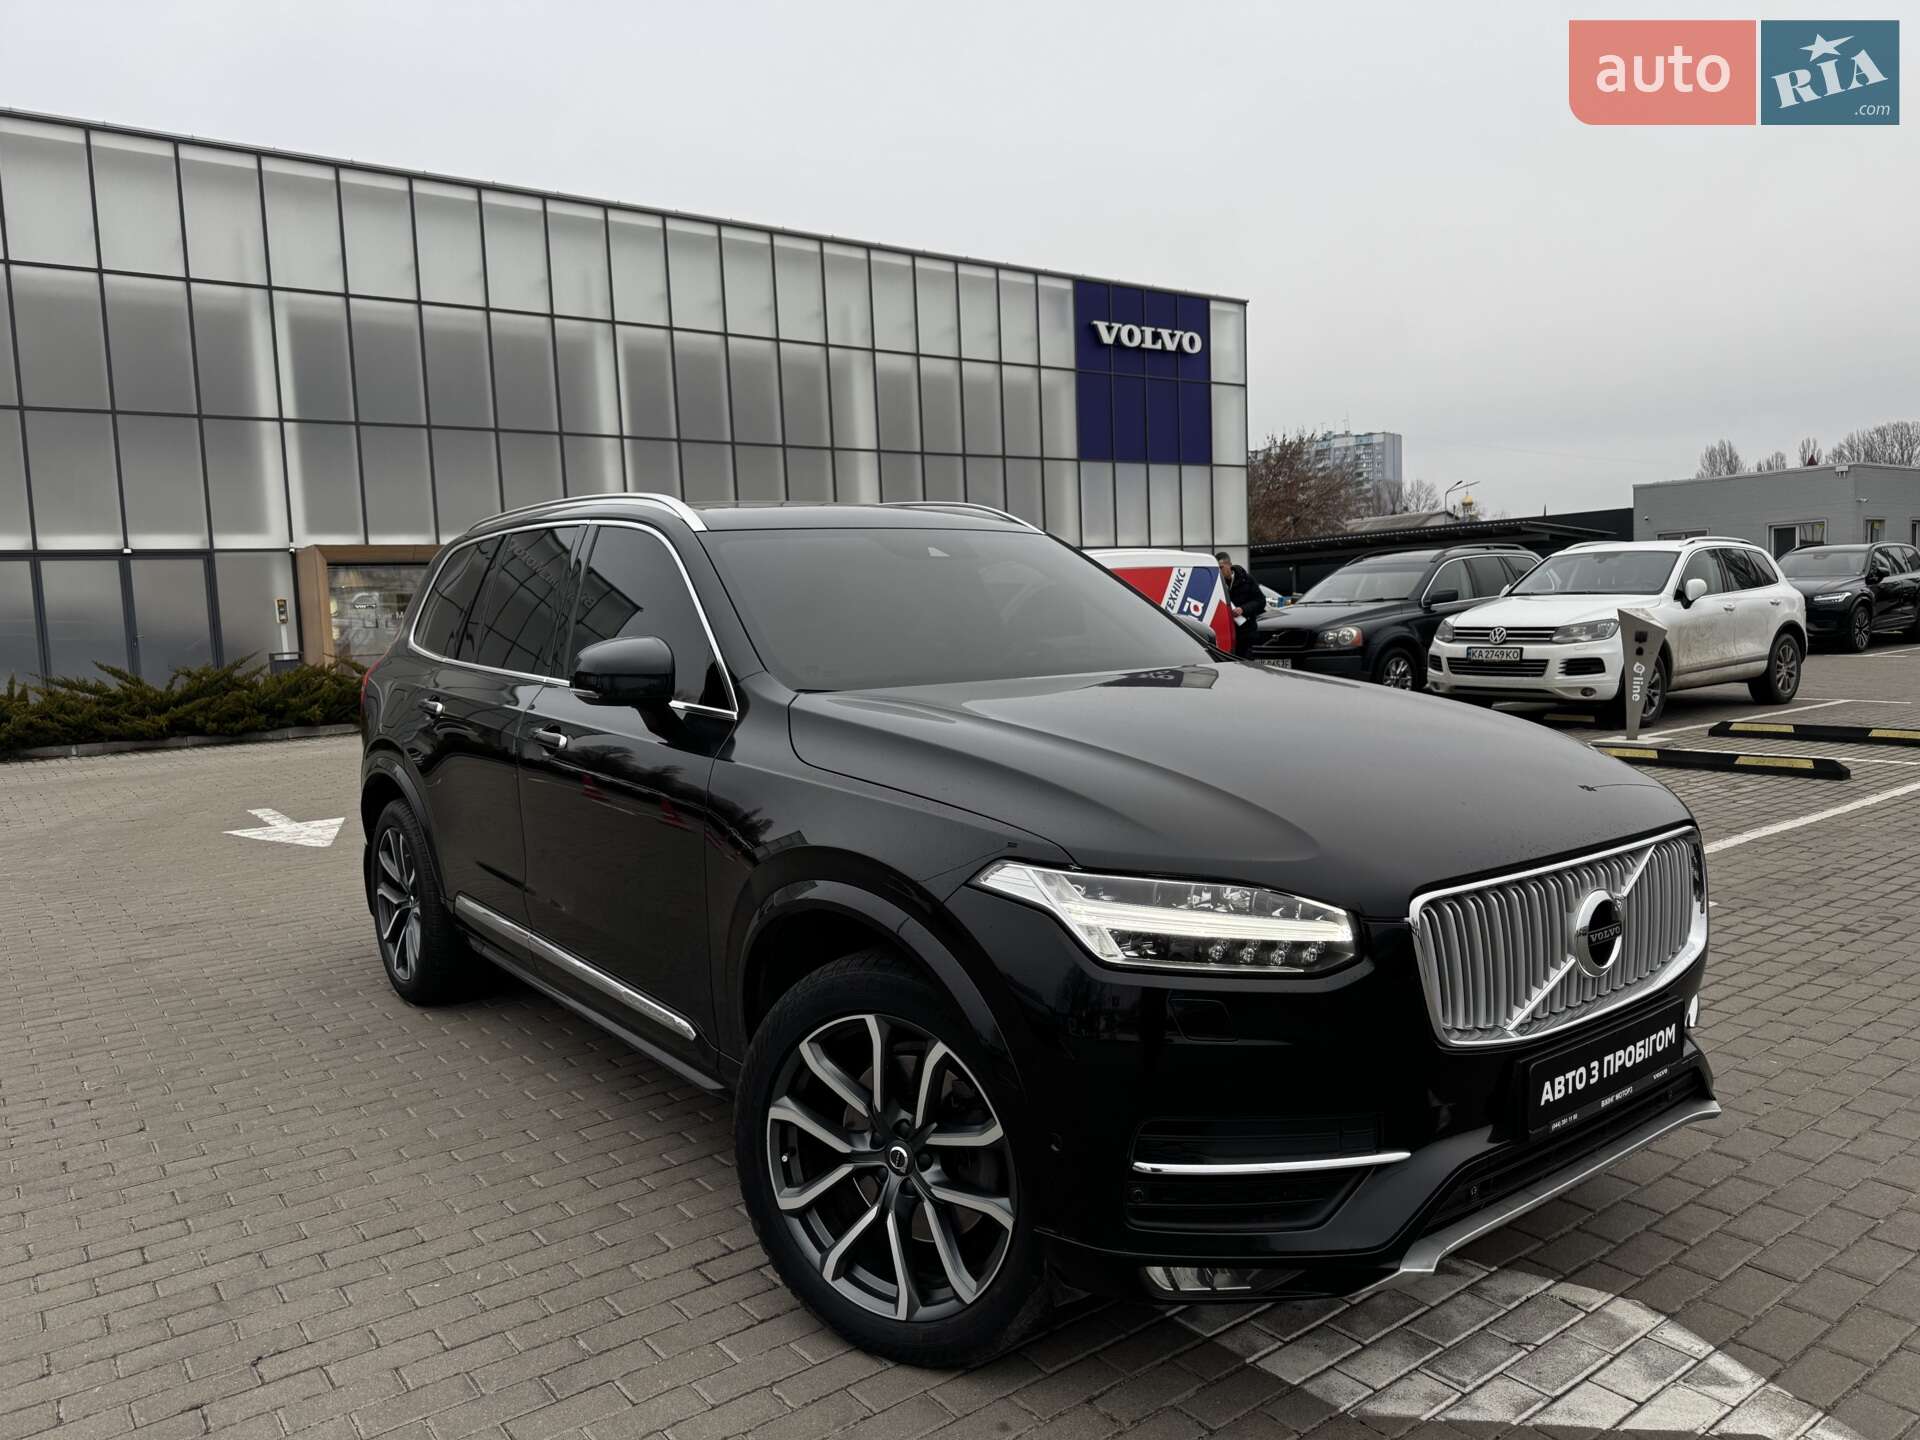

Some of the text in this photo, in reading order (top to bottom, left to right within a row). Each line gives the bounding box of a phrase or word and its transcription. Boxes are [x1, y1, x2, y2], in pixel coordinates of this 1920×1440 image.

[1091, 320, 1202, 354] VOLVO
[1590, 926, 1620, 943] VOLVO
[1540, 1023, 1676, 1107] АВТО З ПРОБІГОМ
